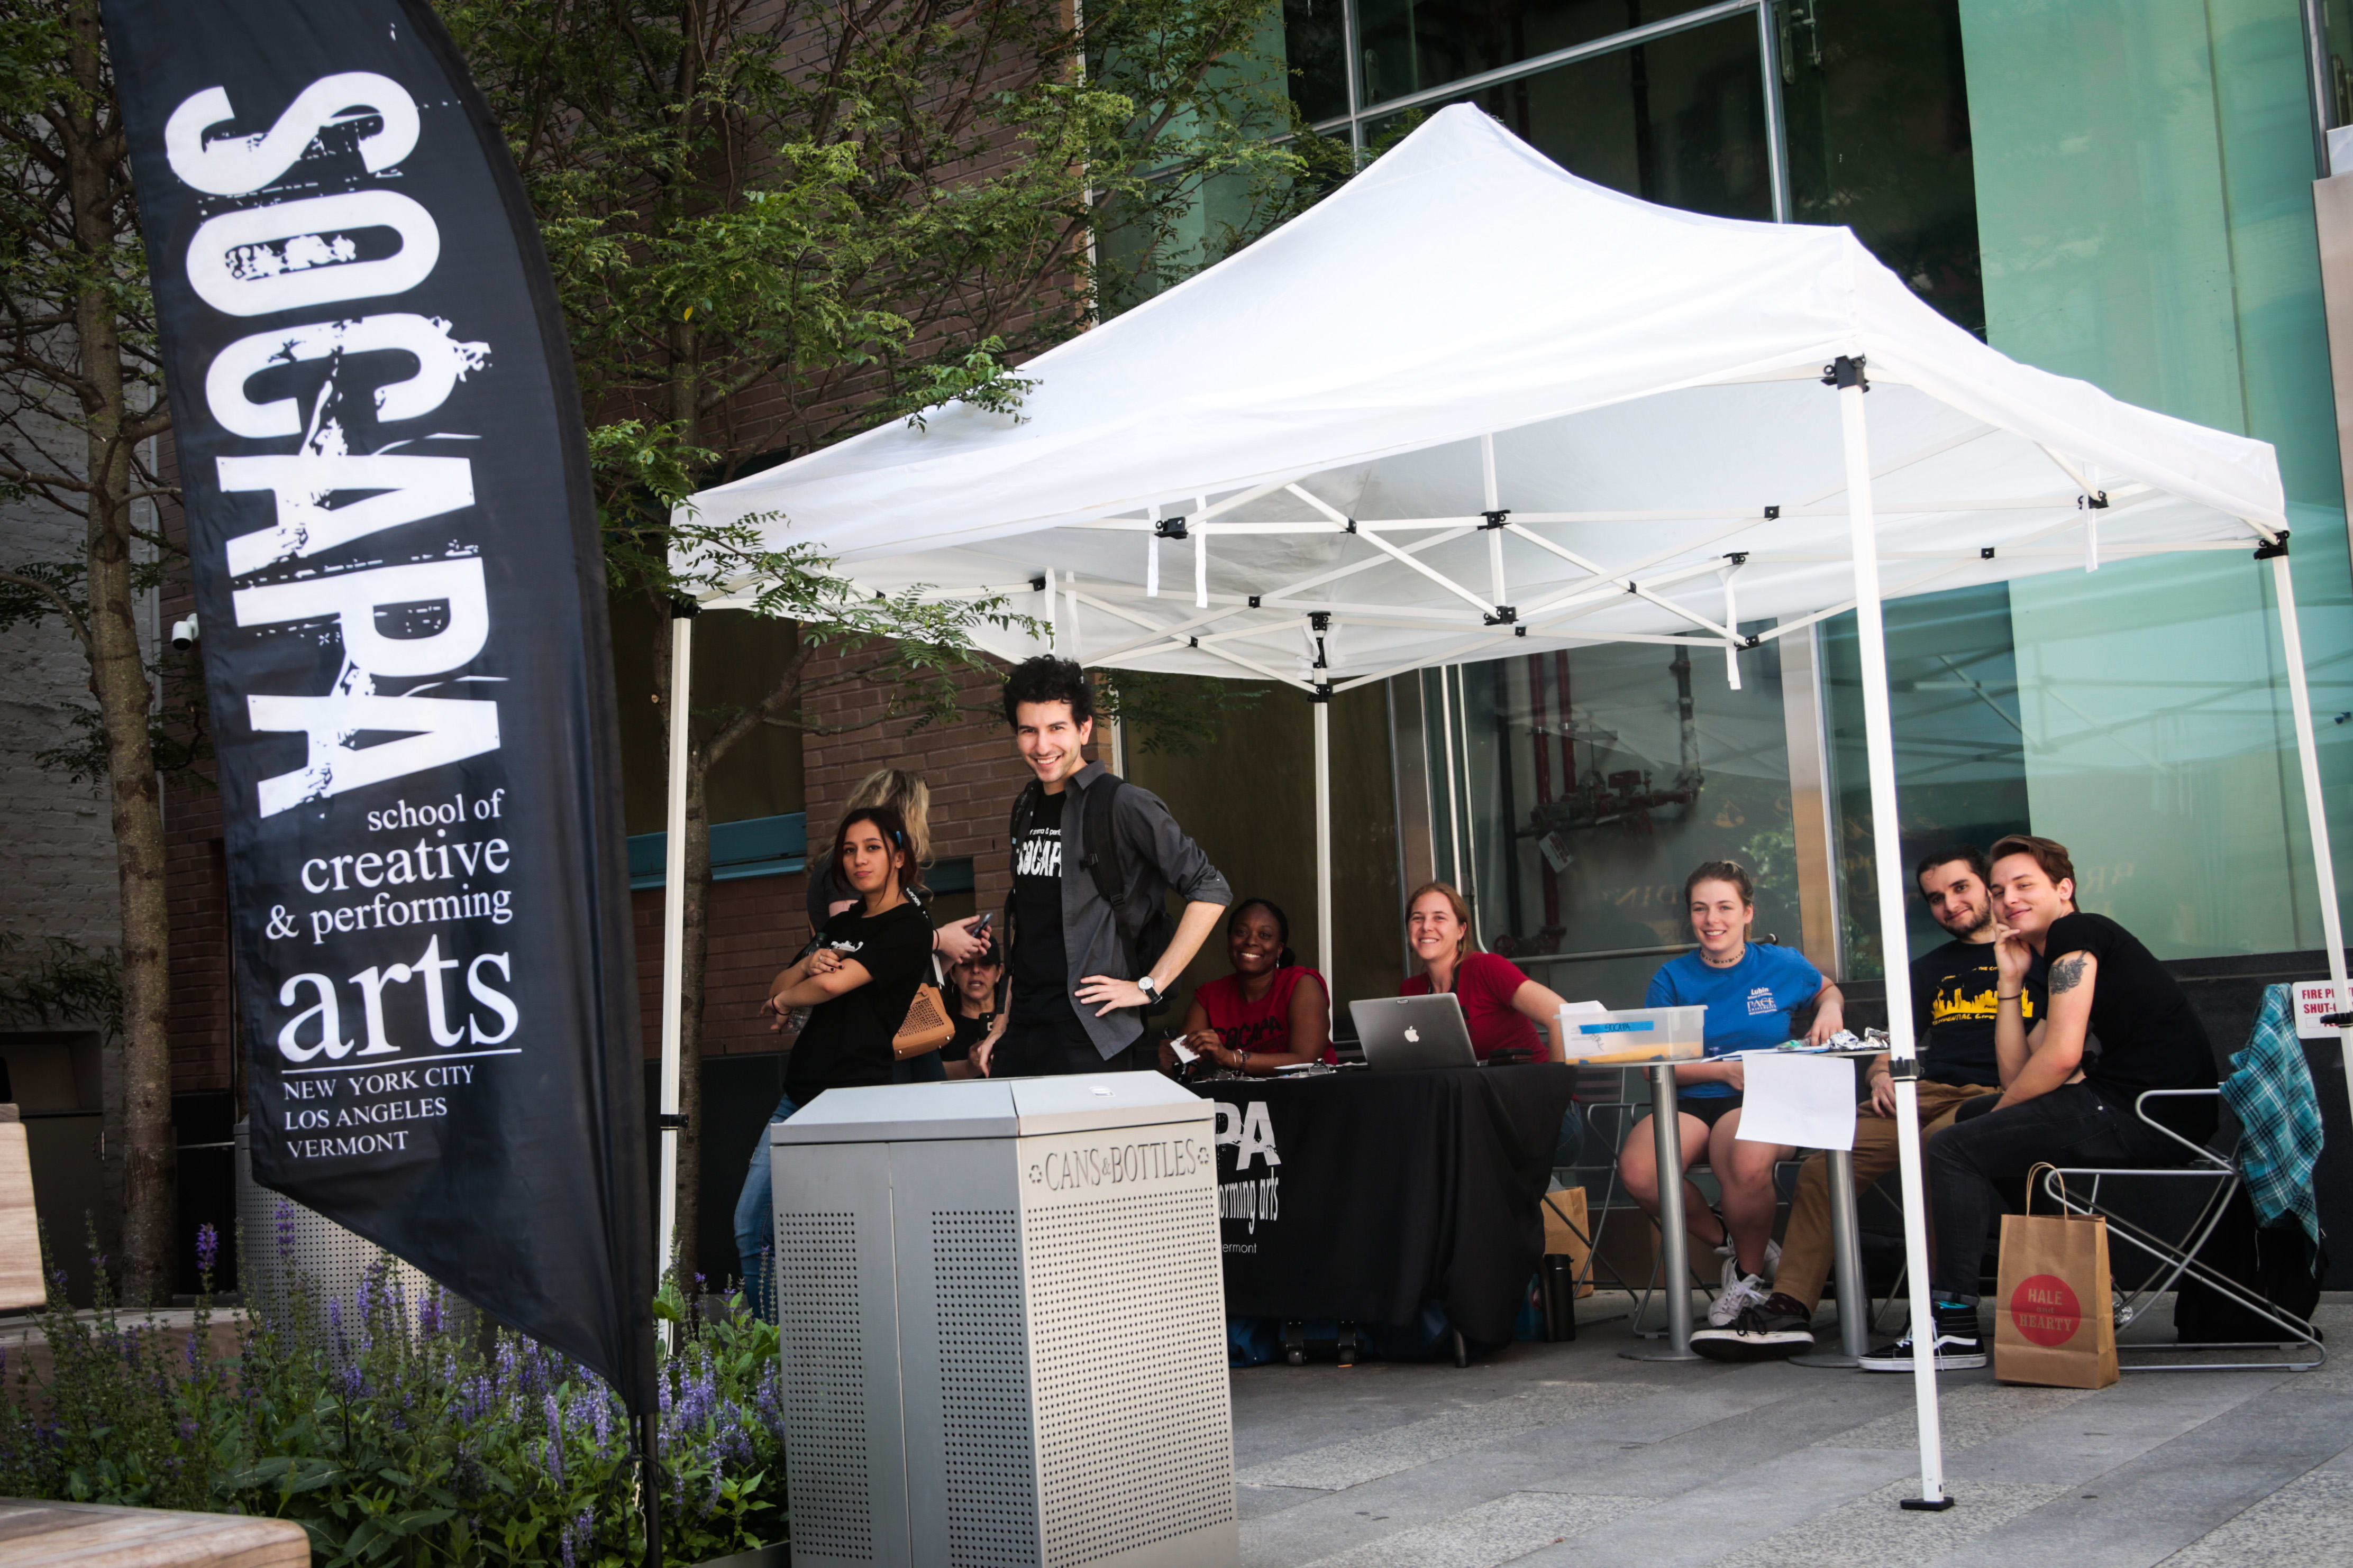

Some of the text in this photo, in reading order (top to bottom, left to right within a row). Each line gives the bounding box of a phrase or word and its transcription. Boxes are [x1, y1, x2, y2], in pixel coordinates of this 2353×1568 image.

[165, 71, 501, 818] SOCAPA
[368, 788, 505, 832] school of
[301, 828, 510, 894] creative
[1017, 836, 1062, 877] SOCAP
[266, 883, 513, 945] & performing
[278, 933, 519, 1062] arts
[1751, 987, 1769, 995] Lubin
[2302, 988, 2323, 1000] FIRE
[283, 1065, 475, 1101] NEW YORK CITY
[284, 1096, 448, 1131] LOS ANGELES
[286, 1130, 409, 1159] VERMONT
[1215, 1101, 1282, 1171] PA
[1218, 1167, 1279, 1235] orming arts
[1221, 1243, 1257, 1254] ermont
[2028, 1288, 2063, 1306] HALE
[2019, 1314, 2073, 1332] HEARTY
